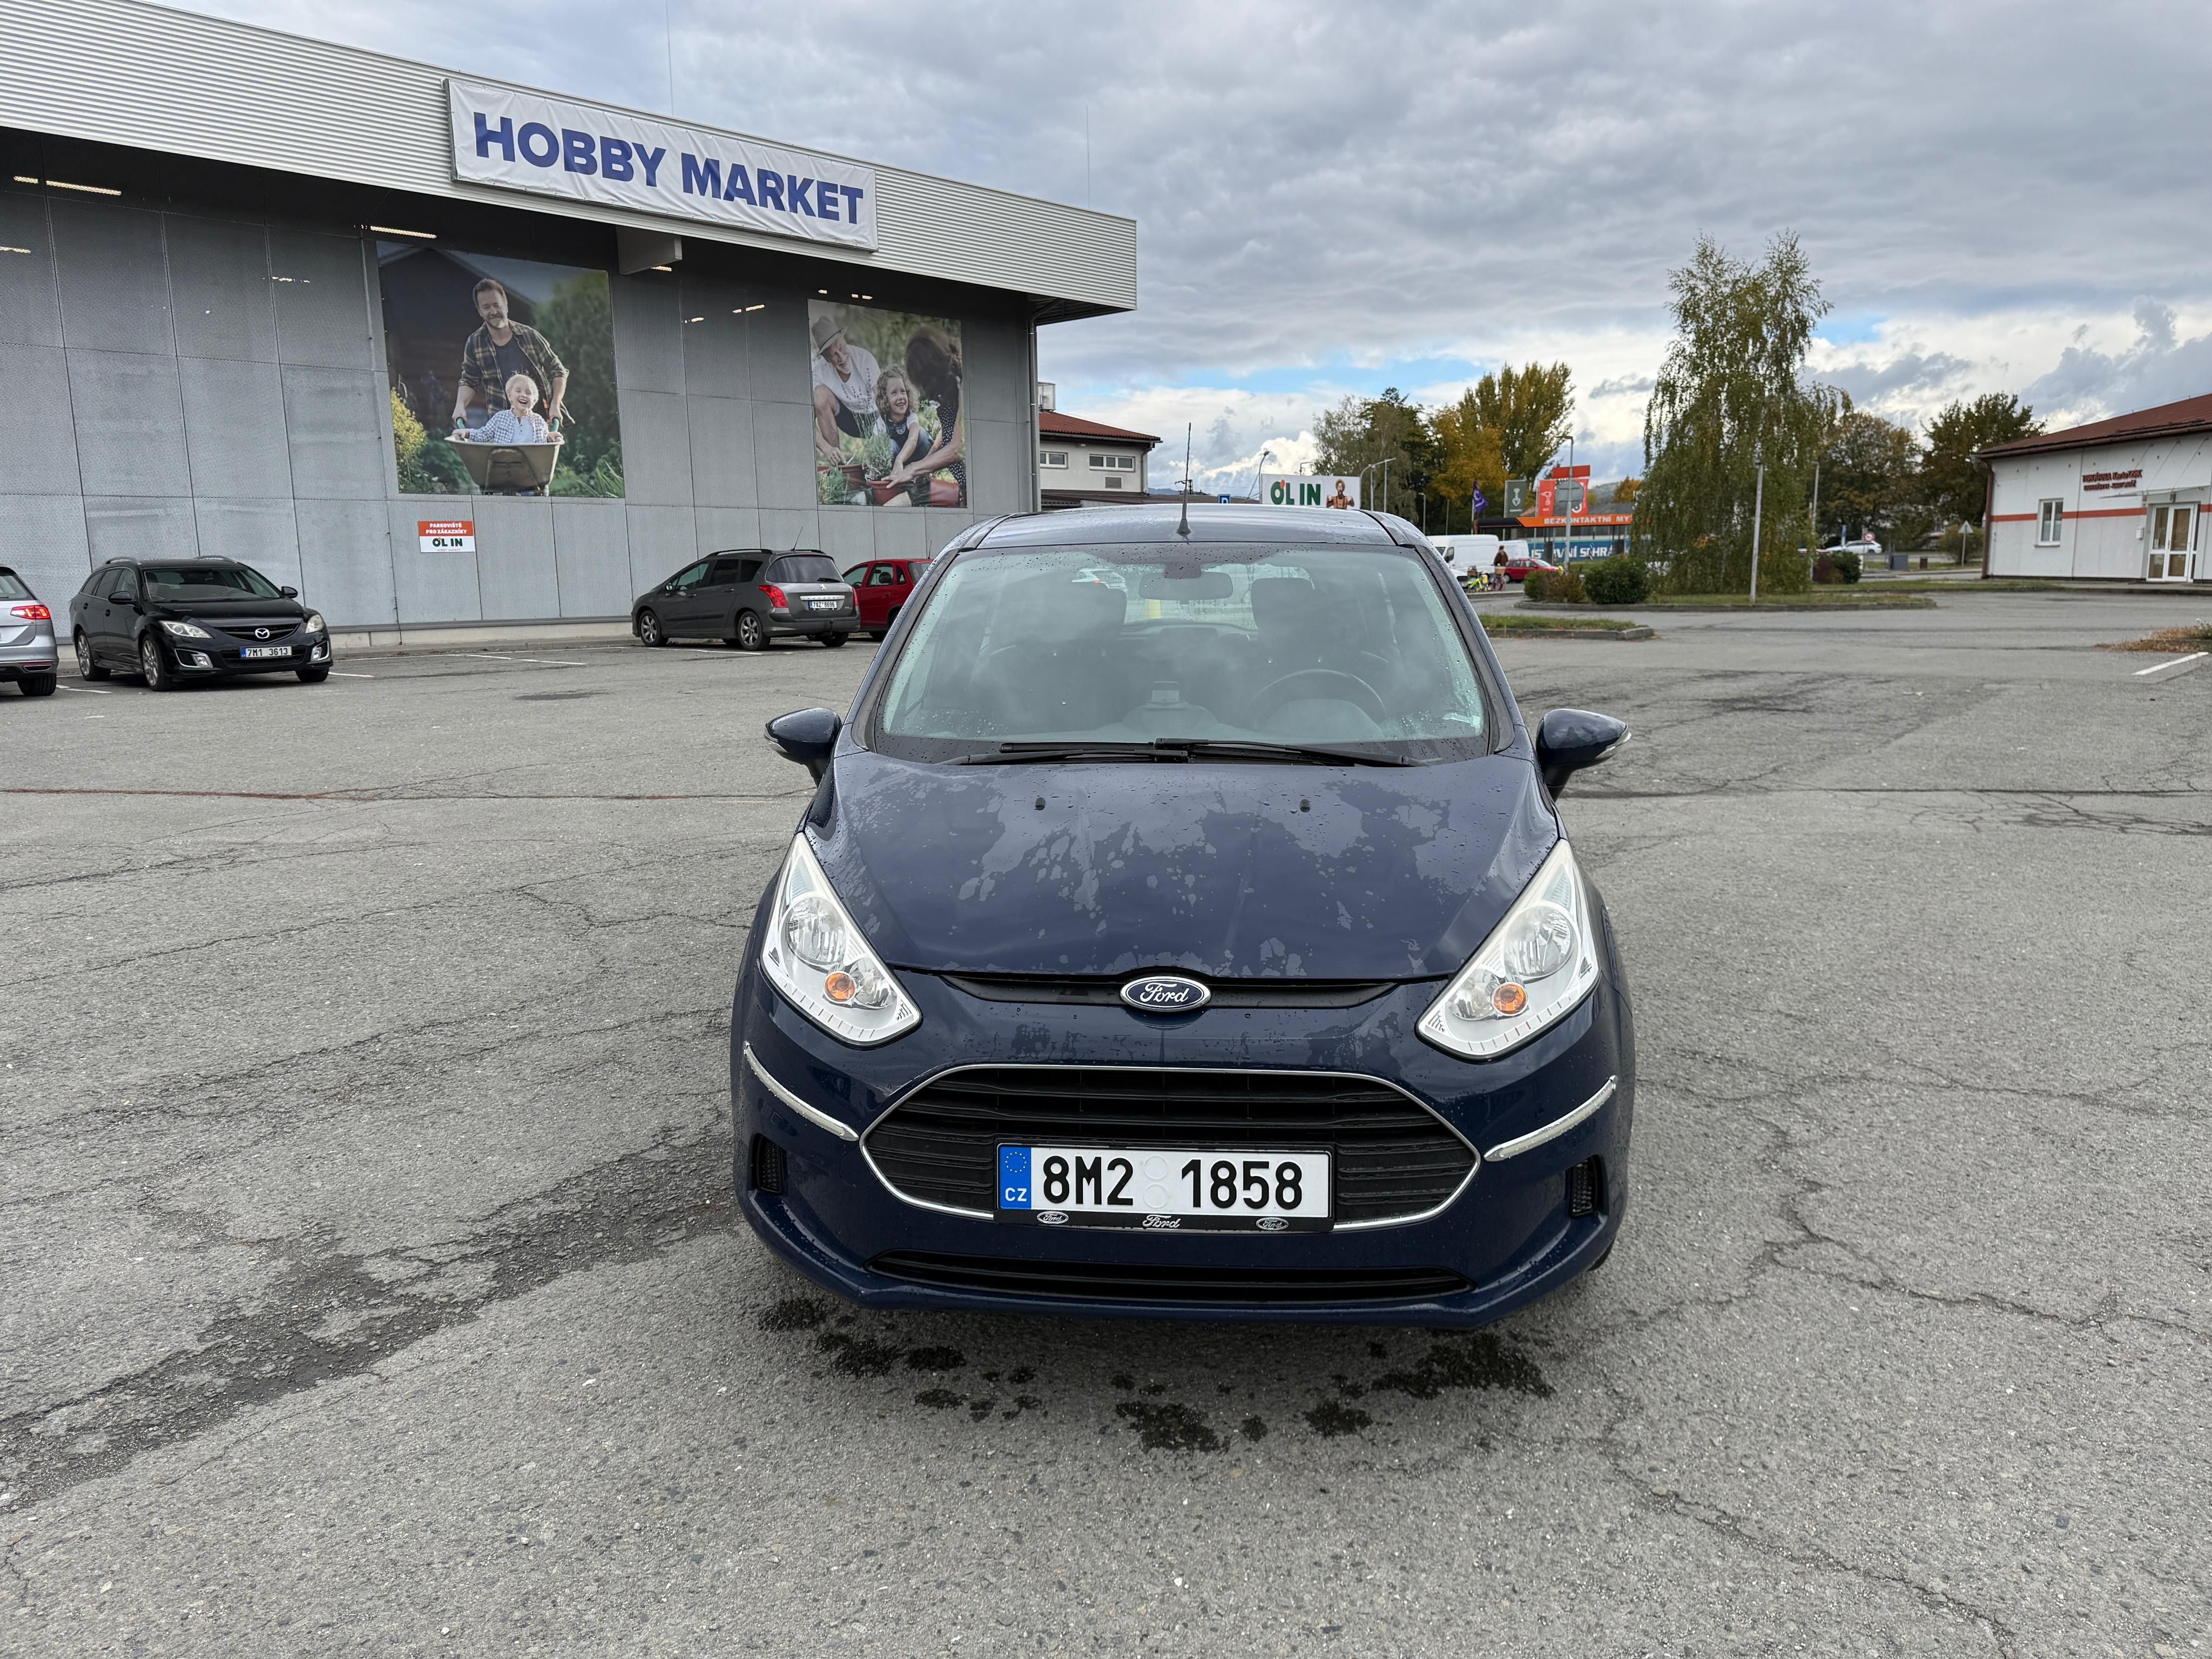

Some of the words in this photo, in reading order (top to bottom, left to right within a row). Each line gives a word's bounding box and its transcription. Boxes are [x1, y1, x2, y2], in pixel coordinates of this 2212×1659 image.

[473, 112, 666, 187] HOBBY
[680, 152, 864, 225] MARKET
[247, 649, 262, 657] 7M1
[269, 648, 288, 656] 3613
[1139, 982, 1190, 1002] Ford
[1043, 1156, 1134, 1206] 8M2
[1181, 1159, 1303, 1210] 1858
[1005, 1188, 1027, 1202] CZ
[1142, 1214, 1181, 1229] Ford
